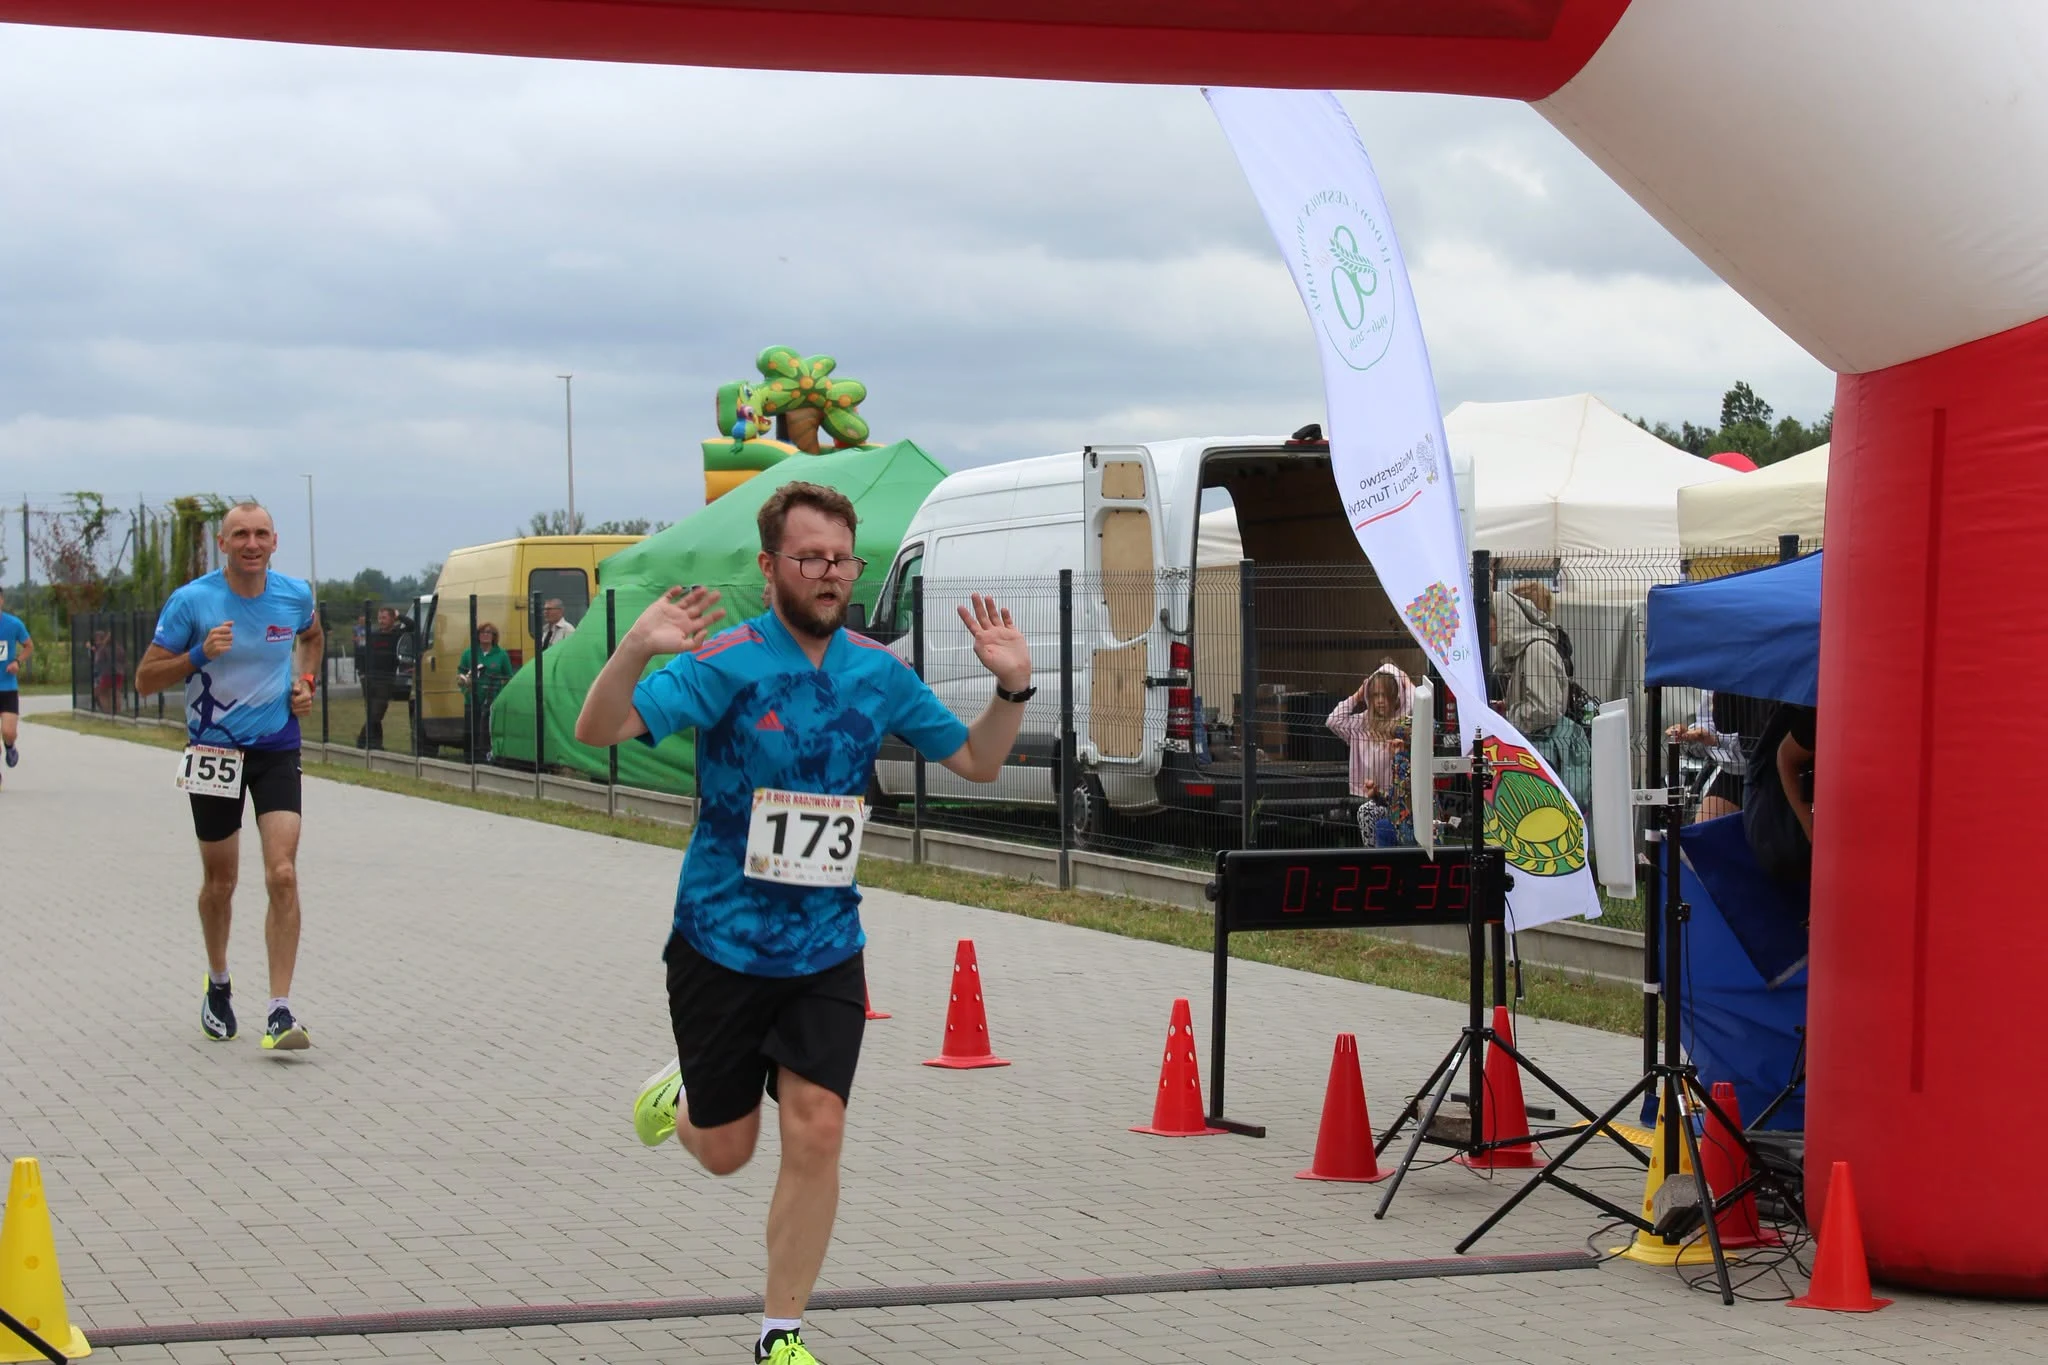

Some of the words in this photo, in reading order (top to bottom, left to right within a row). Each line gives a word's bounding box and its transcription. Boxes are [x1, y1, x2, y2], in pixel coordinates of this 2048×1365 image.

[185, 753, 236, 784] 155
[766, 812, 855, 860] 173
[1282, 864, 1471, 913] 0:22:35
